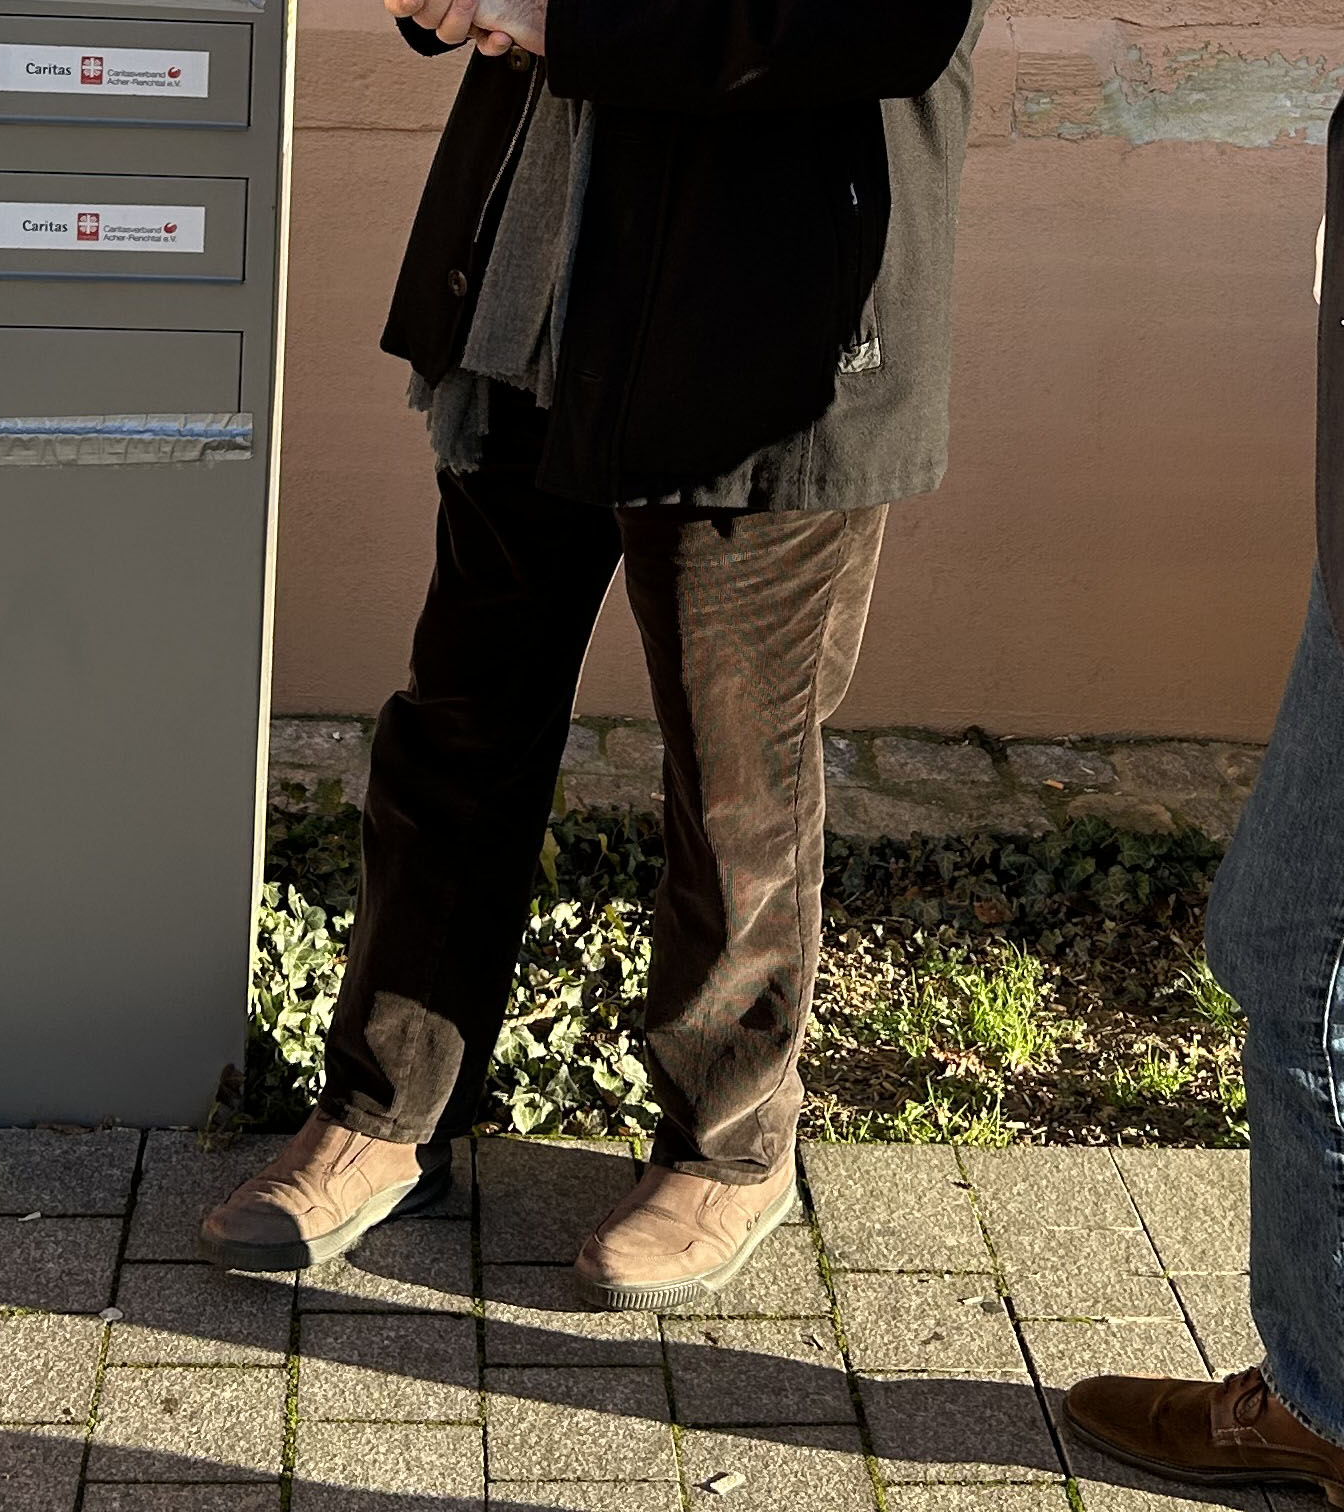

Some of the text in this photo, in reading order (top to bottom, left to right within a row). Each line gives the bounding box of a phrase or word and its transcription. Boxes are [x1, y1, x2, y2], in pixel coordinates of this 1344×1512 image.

[25, 62, 72, 76] Caritas
[107, 68, 166, 79] Caritasverband
[22, 219, 68, 233] Caritas
[103, 224, 162, 234] Caritasverband
